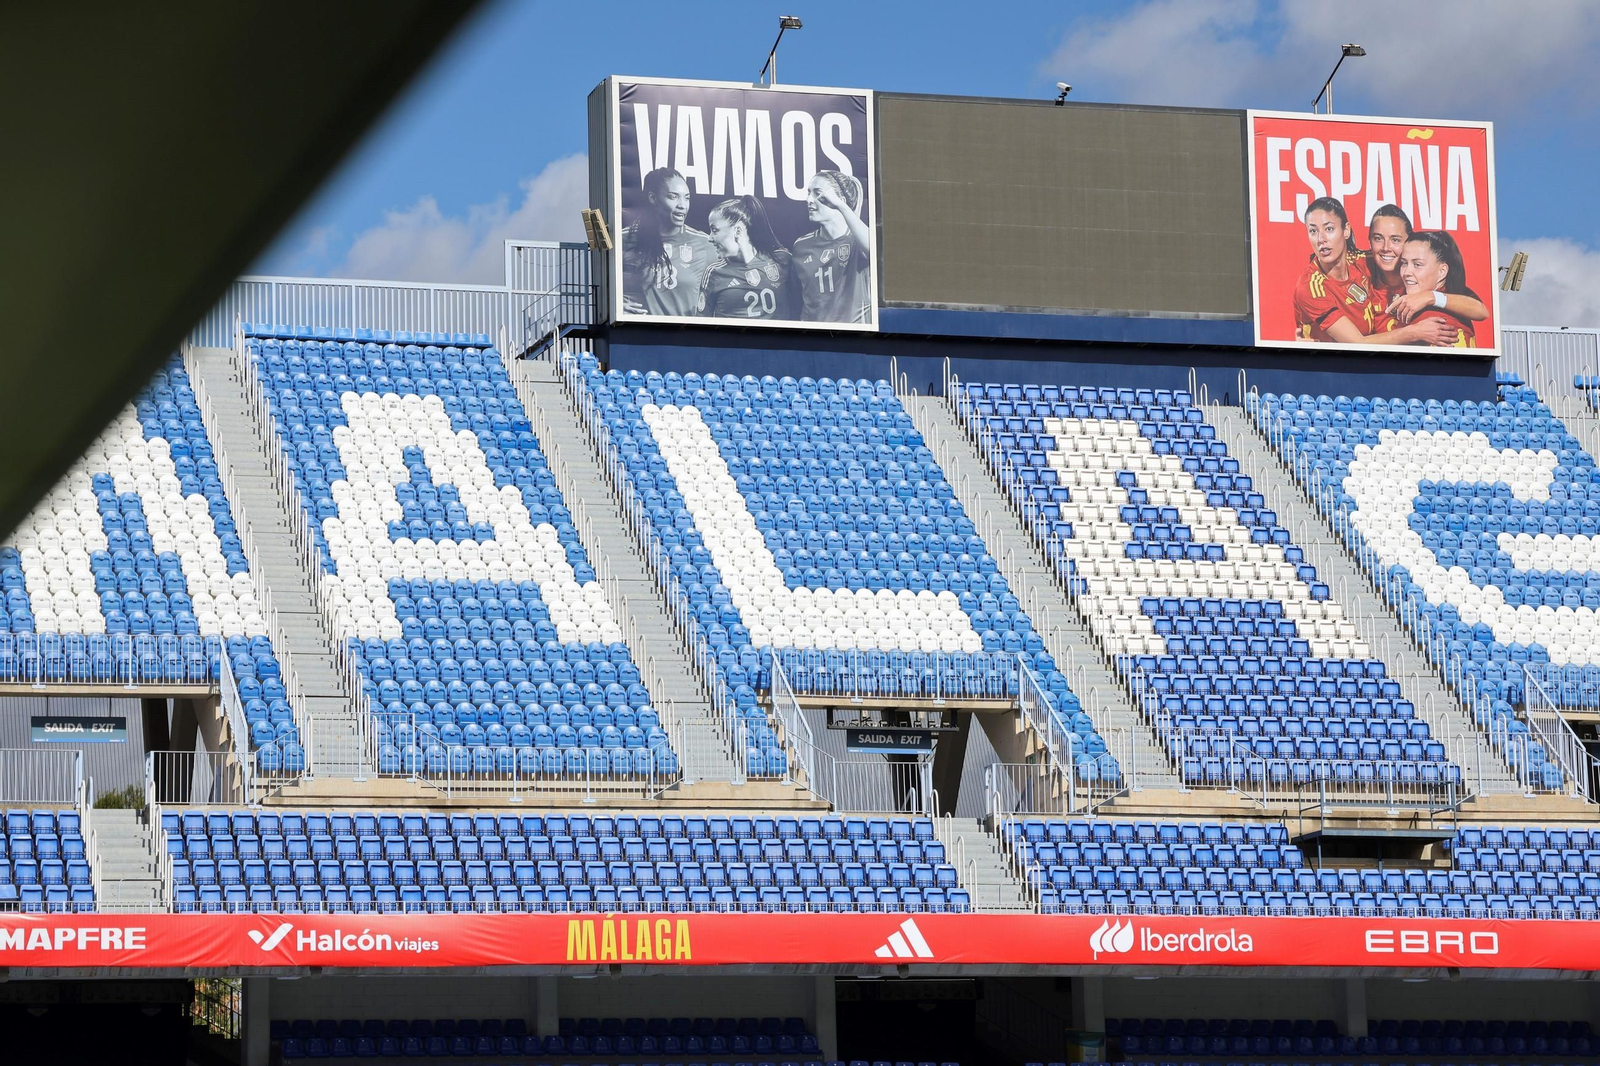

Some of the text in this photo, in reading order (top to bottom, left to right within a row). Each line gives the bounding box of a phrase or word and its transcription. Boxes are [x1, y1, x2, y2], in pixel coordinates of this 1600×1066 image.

[633, 102, 853, 201] VAMOS
[1266, 128, 1480, 232] ESPAÑA
[814, 266, 834, 293] 11
[744, 288, 777, 317] 20
[44, 722, 116, 733] SALIDA EXIT
[858, 734, 922, 745] SALIDA EXIT
[0, 927, 146, 951] MAPFRE
[297, 928, 440, 954] Halcón viajes
[566, 914, 692, 961] MÁLAGA
[1140, 927, 1254, 952] Iberdrola
[1365, 929, 1499, 955] EBRO
